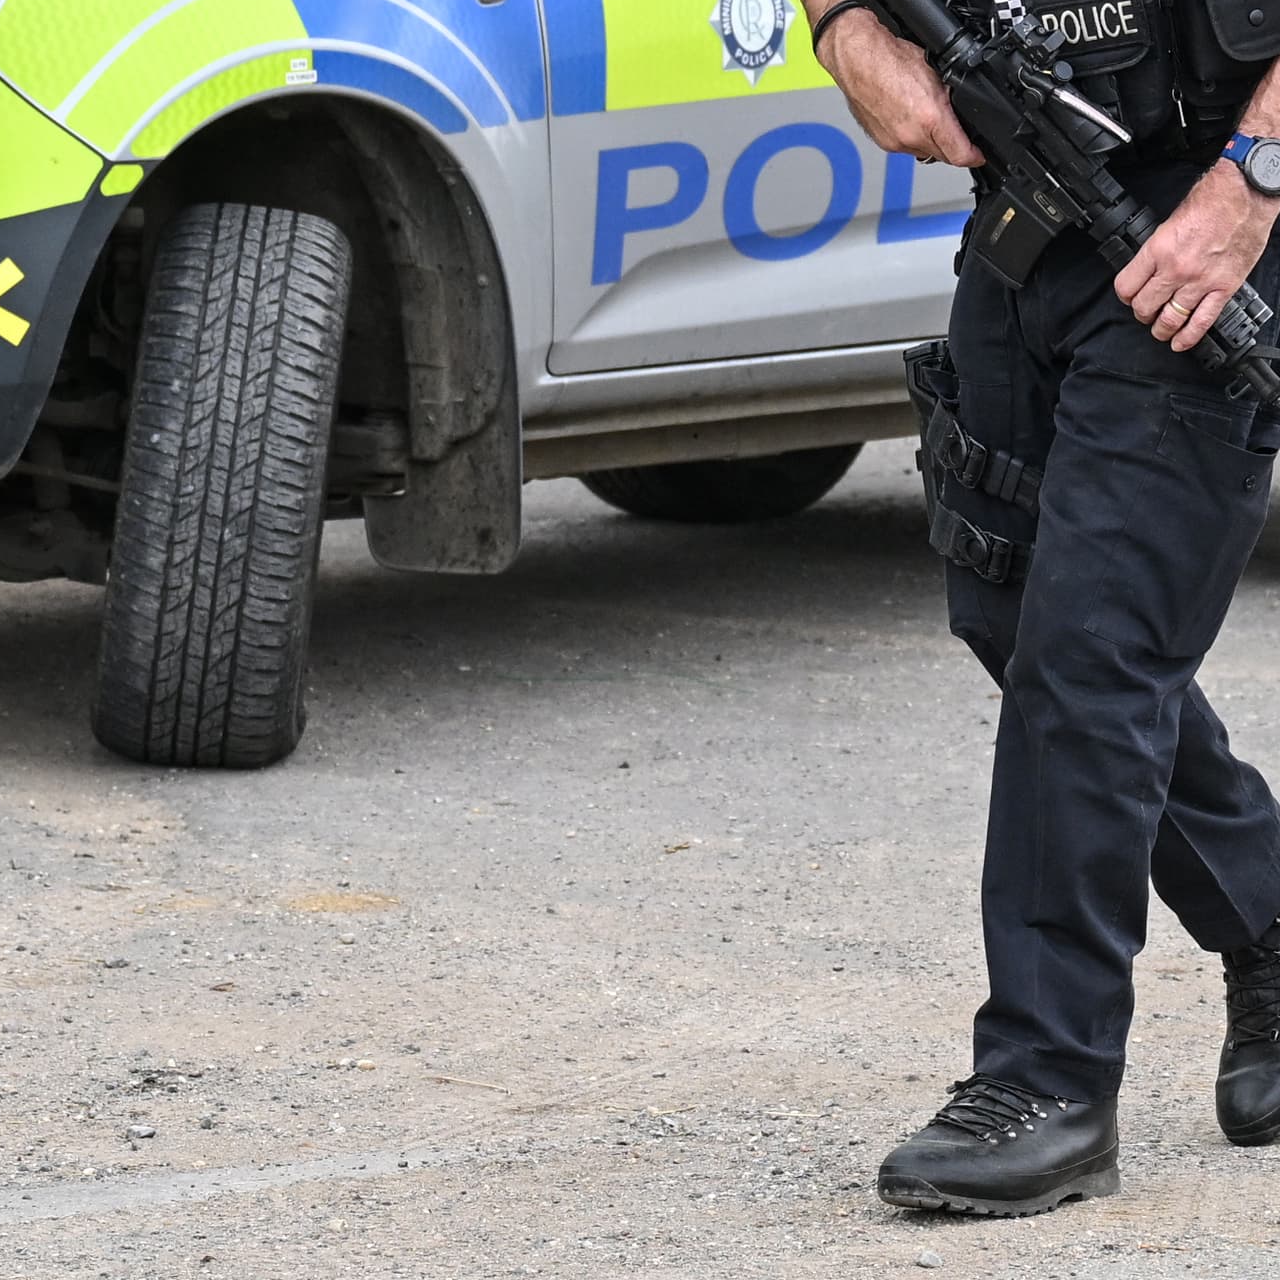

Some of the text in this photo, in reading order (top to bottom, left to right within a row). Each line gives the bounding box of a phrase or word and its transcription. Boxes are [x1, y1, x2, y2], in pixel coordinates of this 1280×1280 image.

[1041, 0, 1138, 44] POLICE
[735, 45, 773, 66] POLICE
[590, 121, 972, 286] POL
